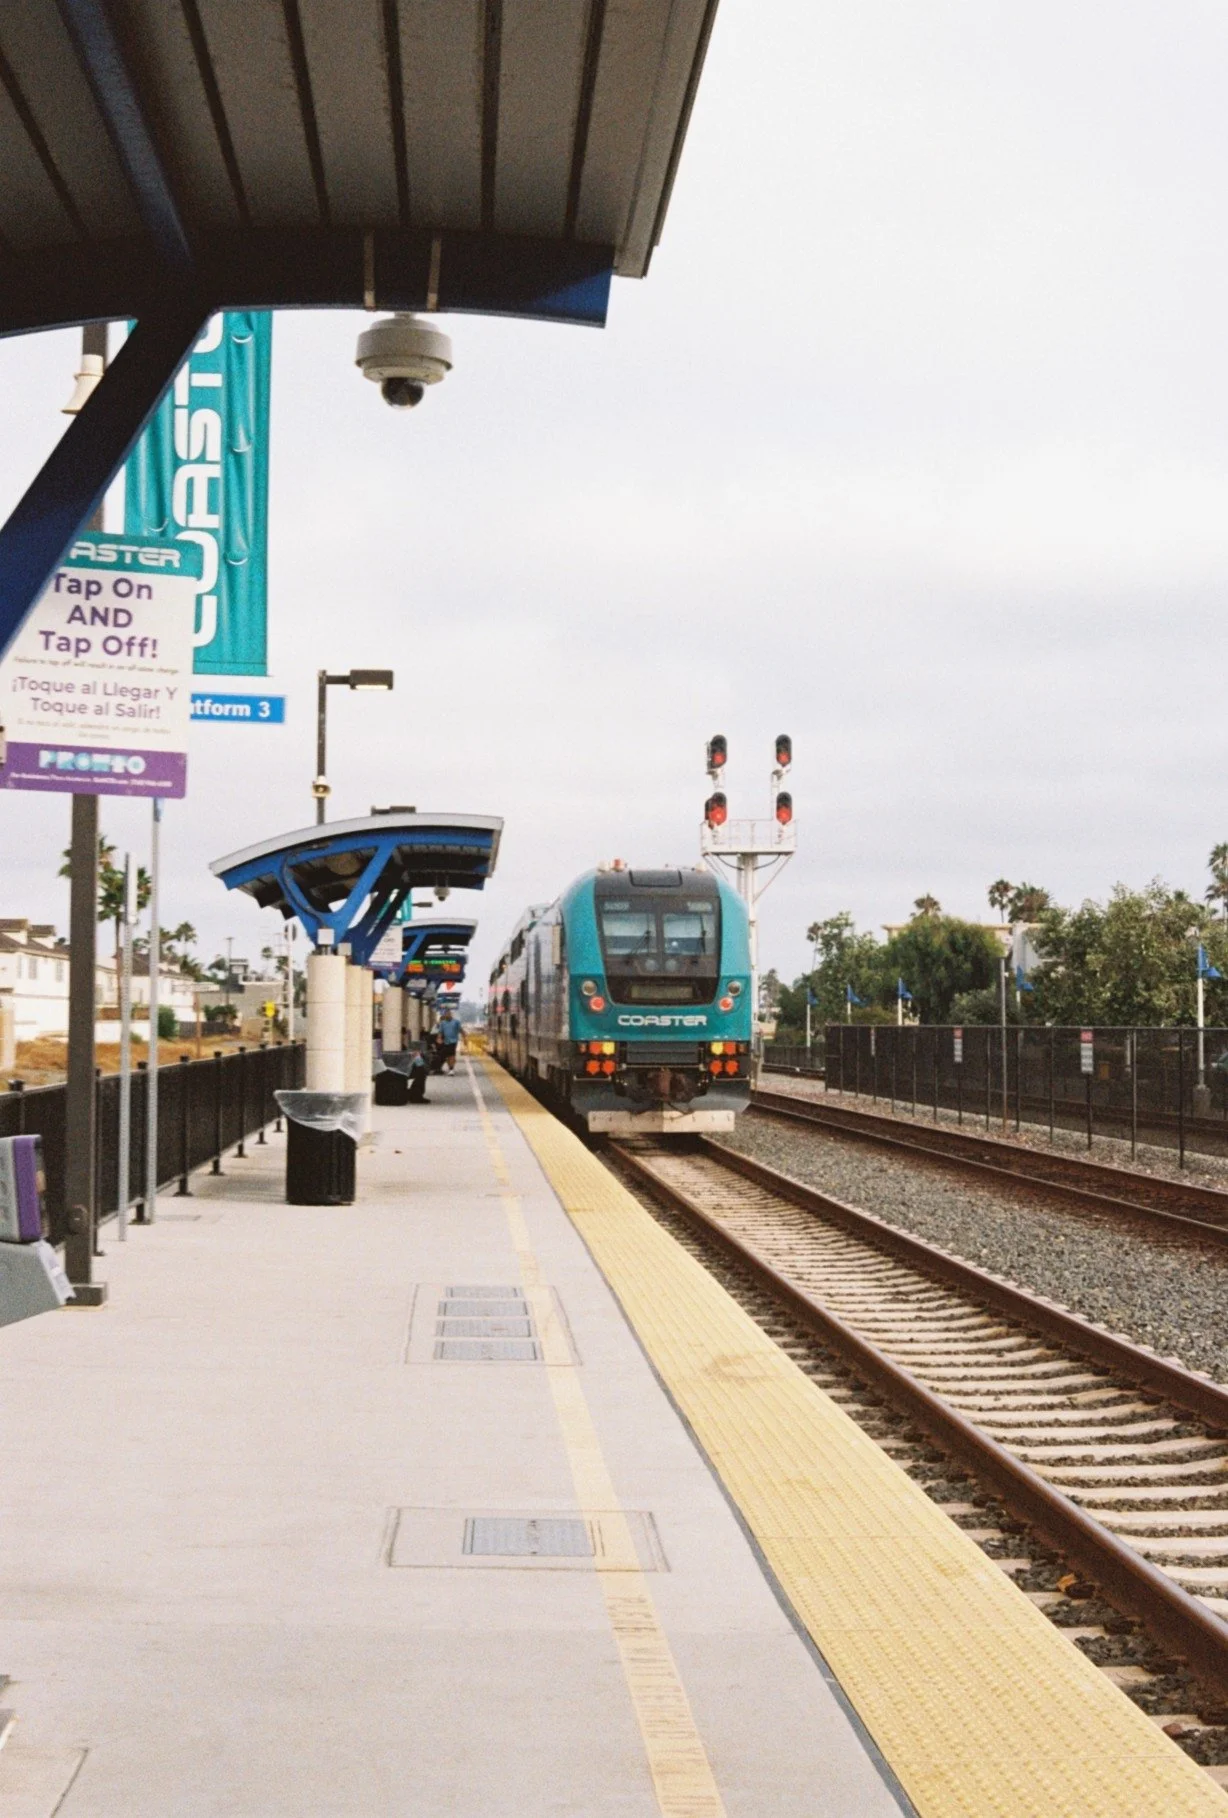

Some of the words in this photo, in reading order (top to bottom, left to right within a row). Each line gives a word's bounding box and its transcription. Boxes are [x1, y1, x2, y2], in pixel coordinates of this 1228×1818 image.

[54, 573, 103, 600] Tap
[113, 578, 153, 600] On
[67, 605, 133, 628] AND
[39, 630, 92, 658] Tap
[102, 635, 158, 659] Off!
[12, 676, 75, 694] ¡Toque
[81, 681, 97, 696] al
[103, 682, 160, 701] Llegar
[165, 686, 178, 701] Y
[30, 697, 88, 715] Toque
[94, 701, 109, 716] al
[116, 703, 161, 719] Salir!
[258, 701, 270, 718] 3
[617, 1014, 708, 1027] COASTER
